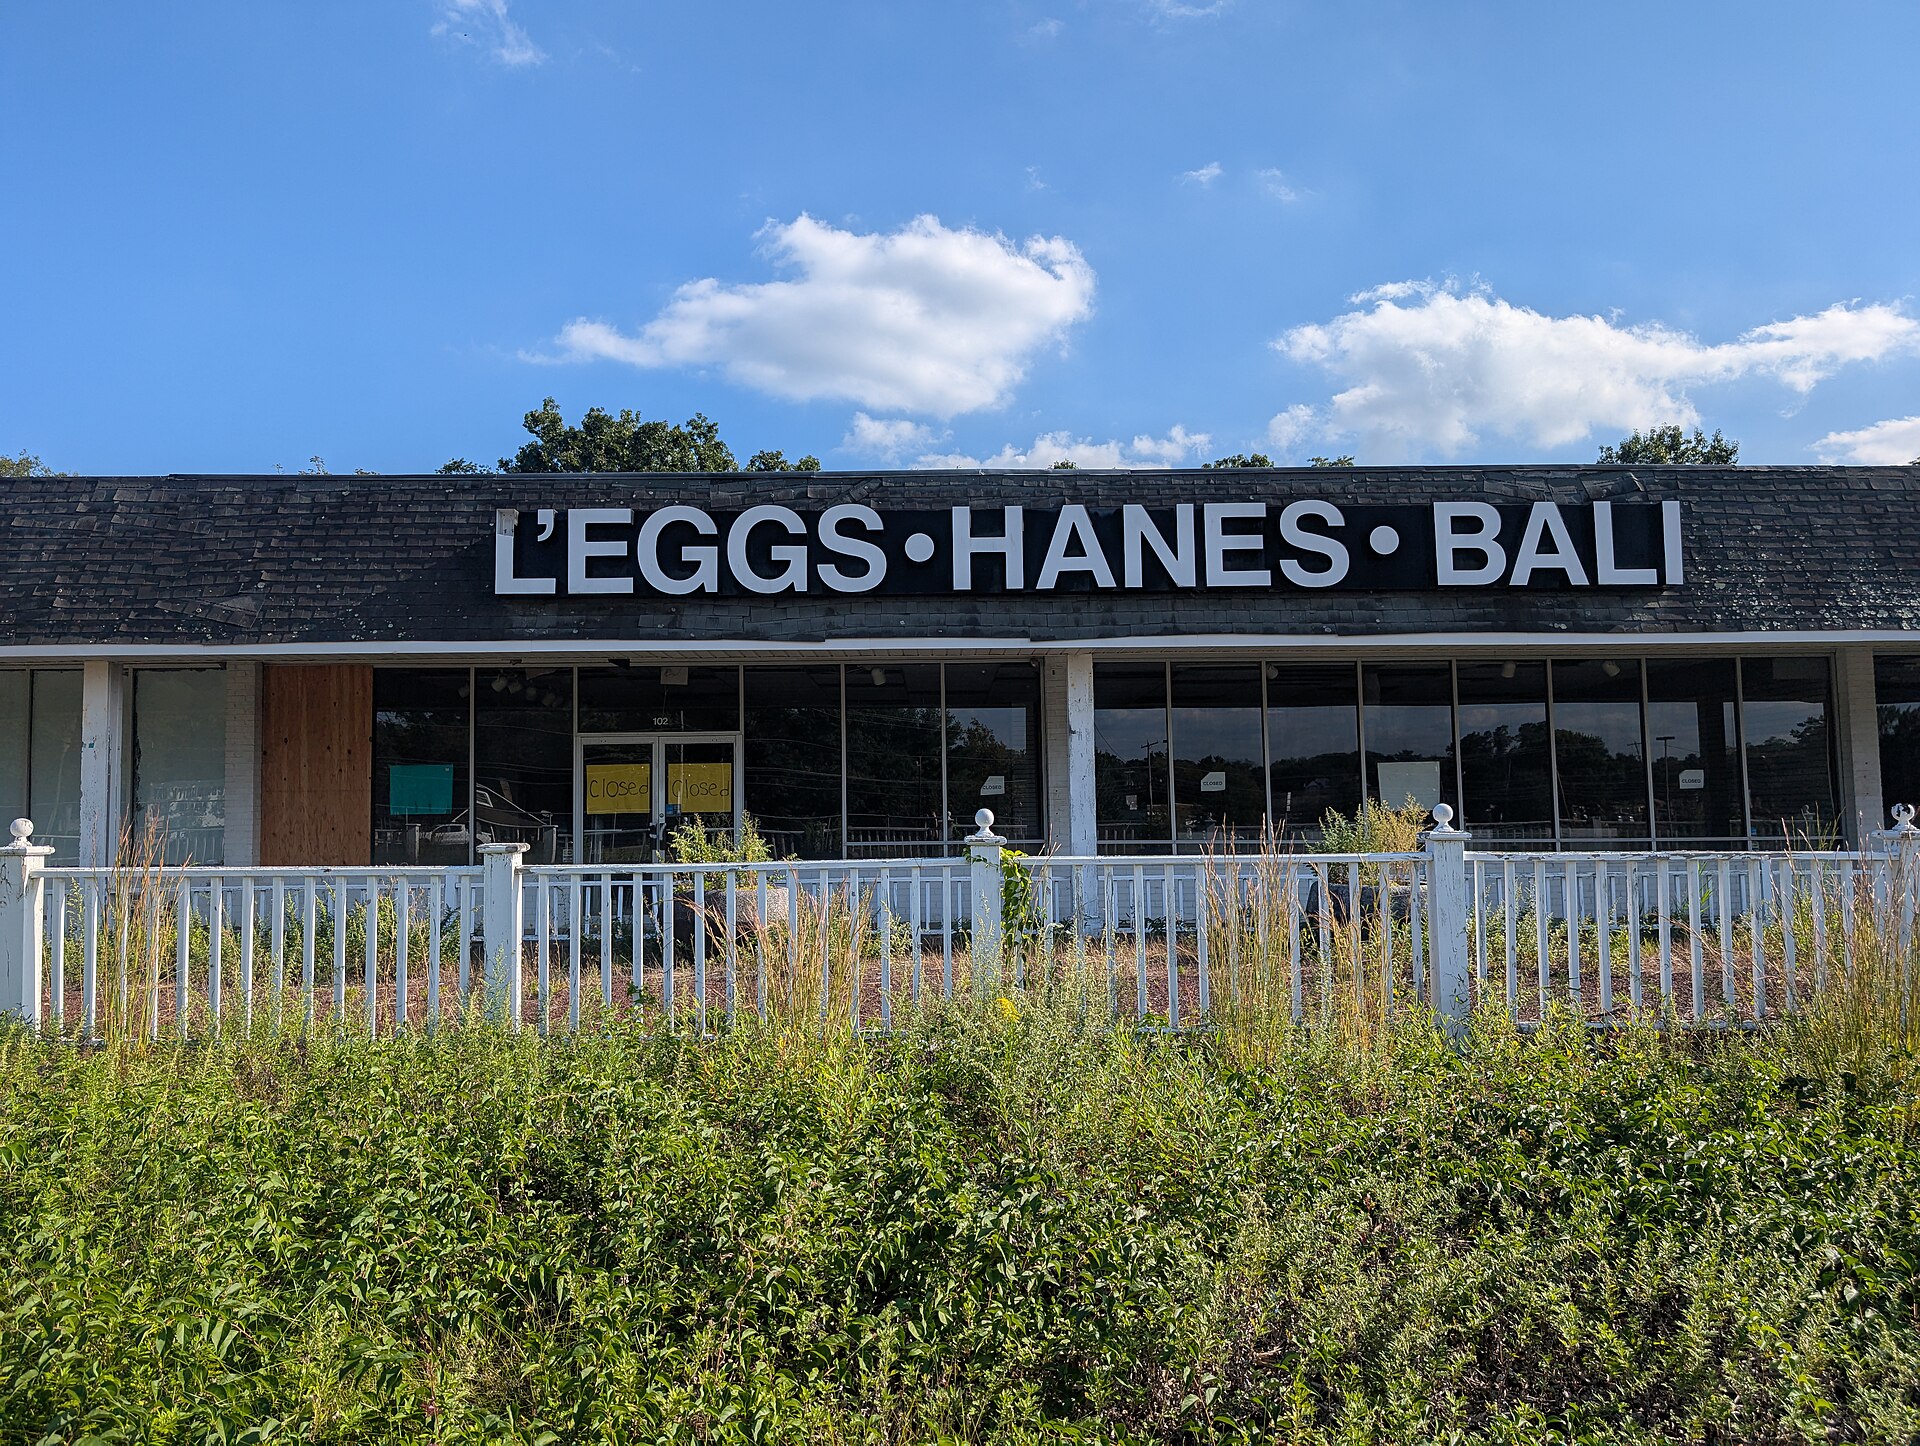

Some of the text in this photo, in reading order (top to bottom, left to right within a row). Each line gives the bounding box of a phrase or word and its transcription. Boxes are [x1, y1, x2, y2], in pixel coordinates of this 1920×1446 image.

[495, 500, 1684, 595] L'EGGS HANES BALI
[652, 717, 669, 726] 102
[589, 778, 648, 798] Closed
[672, 779, 730, 798] Closed
